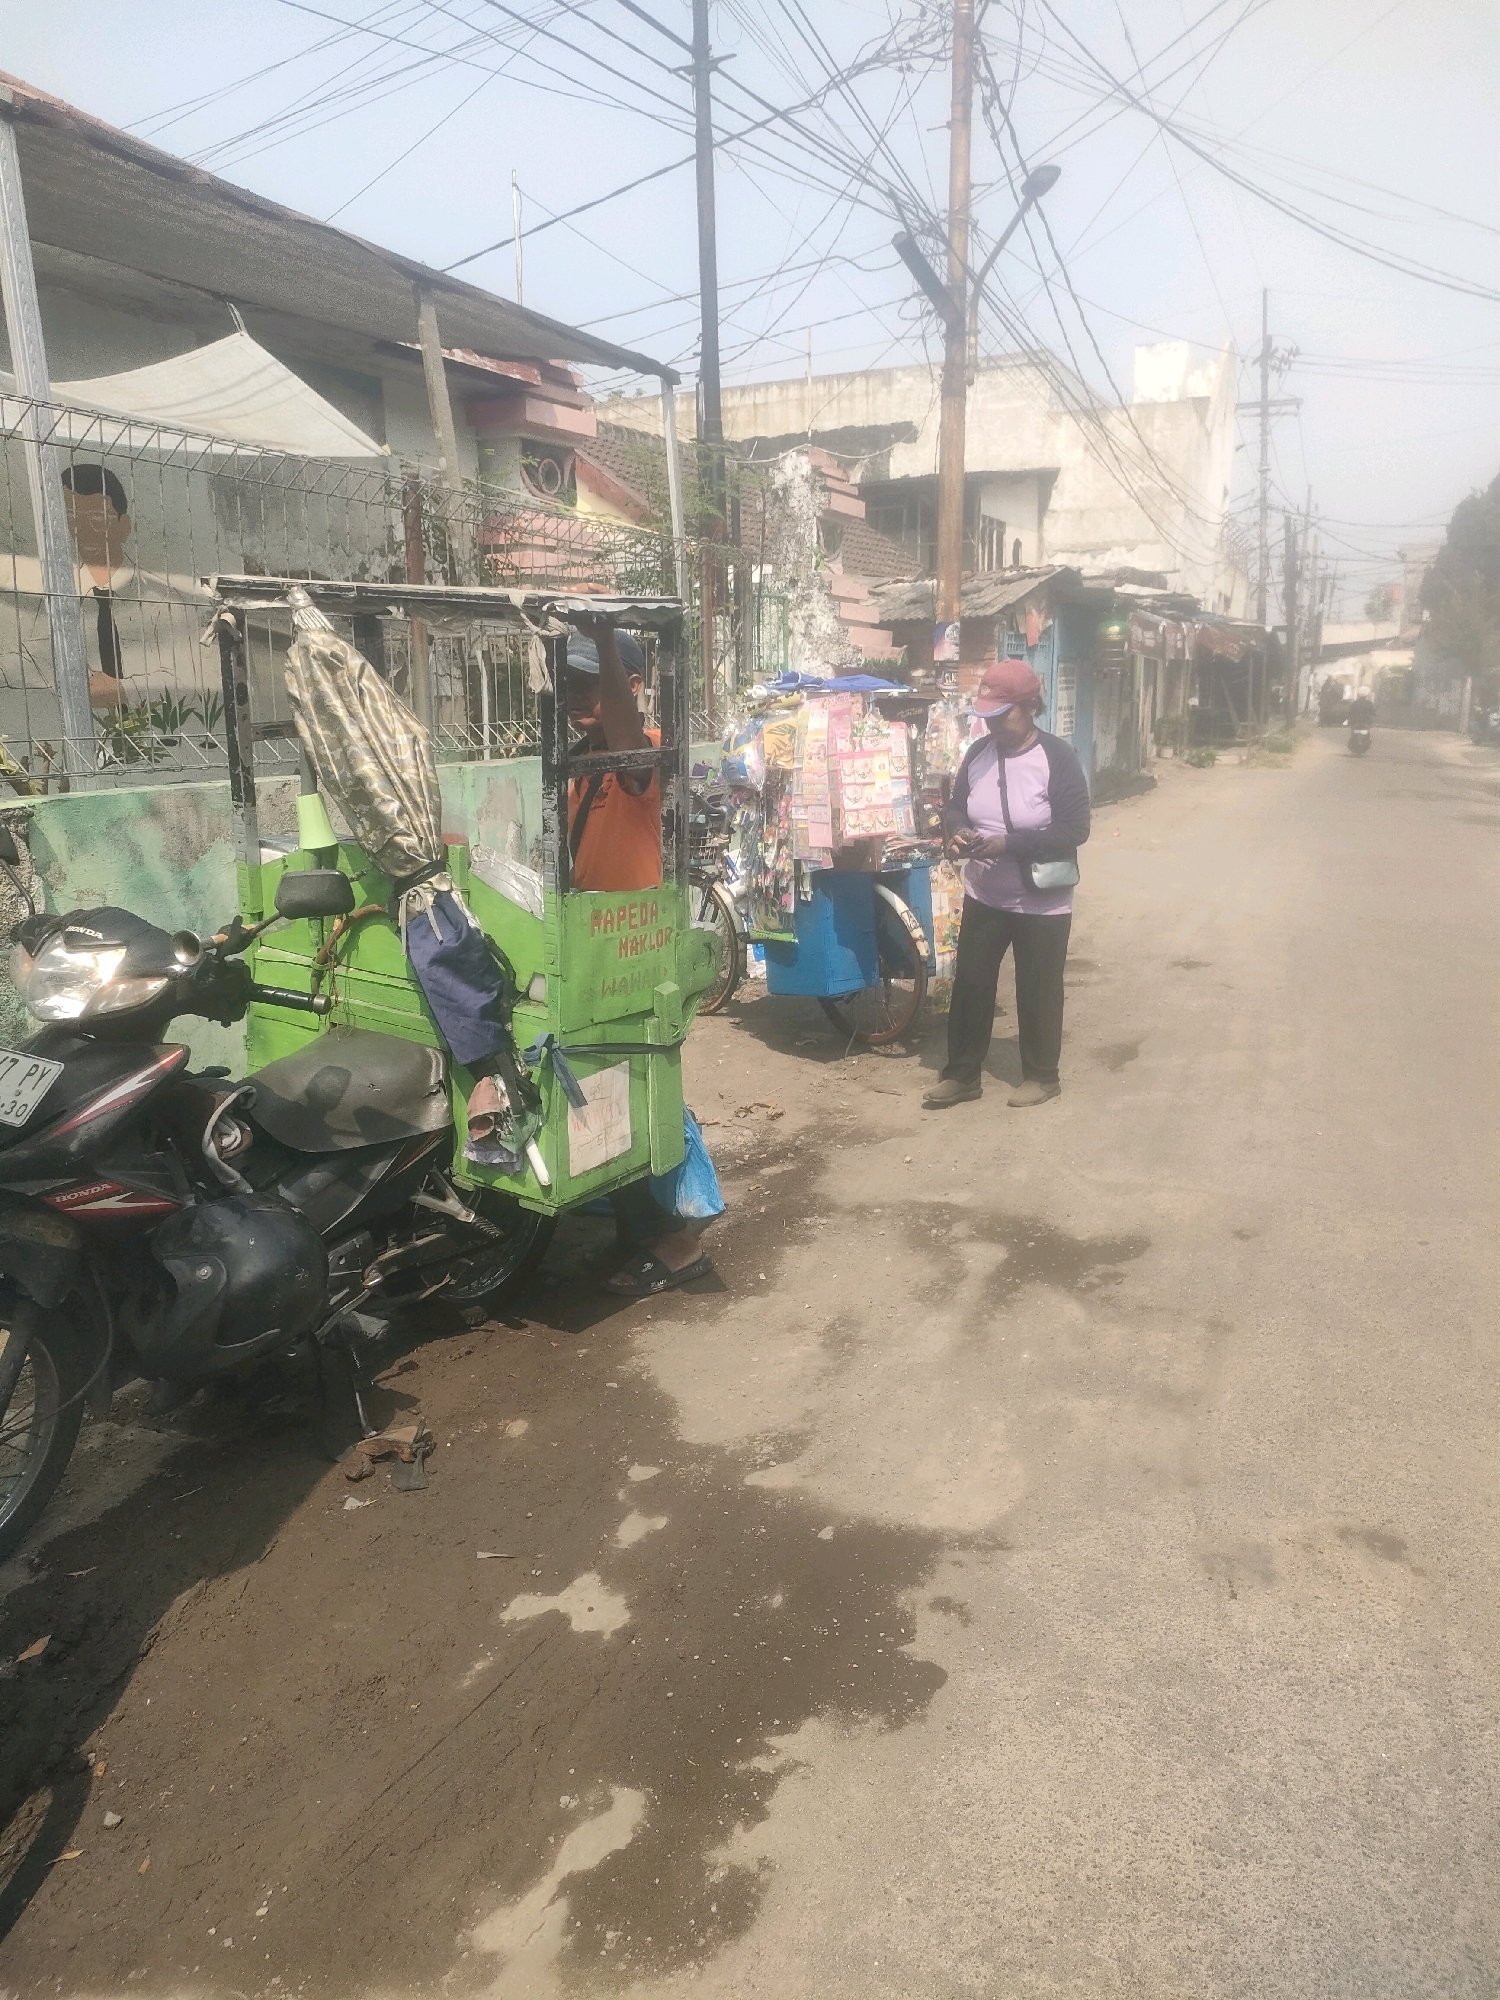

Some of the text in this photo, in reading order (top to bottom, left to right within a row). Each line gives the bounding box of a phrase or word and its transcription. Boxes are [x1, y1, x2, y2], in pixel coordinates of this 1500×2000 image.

[590, 900, 659, 937] PAPEDA
[65, 925, 104, 940] HONDA
[618, 926, 673, 959] MAKLOR
[18, 1064, 52, 1091] PY
[55, 1183, 112, 1203] HONDA
